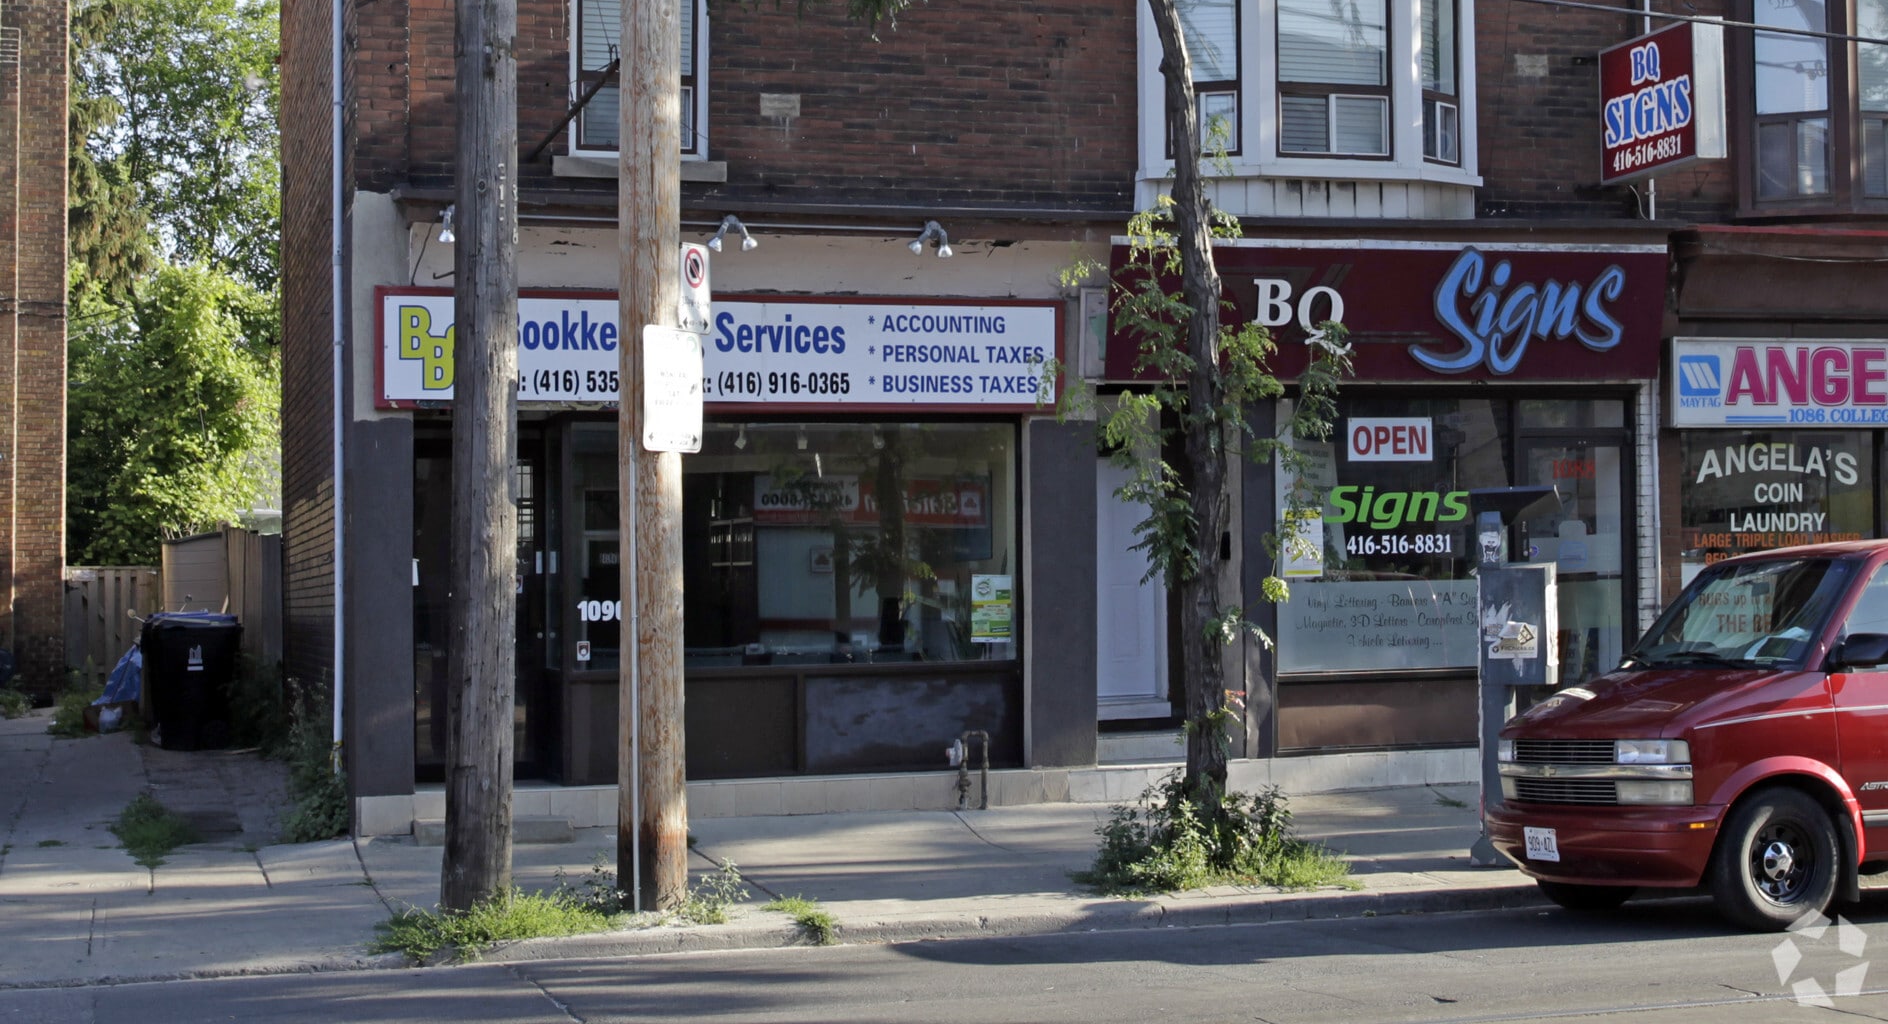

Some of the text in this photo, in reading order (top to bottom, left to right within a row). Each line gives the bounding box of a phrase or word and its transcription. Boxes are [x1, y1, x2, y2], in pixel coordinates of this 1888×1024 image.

[1630, 41, 1661, 86] BQ
[1604, 74, 1691, 149] SIGNS
[1613, 133, 1682, 172] 416-516-8831
[1252, 246, 1625, 374] BQ Signs
[714, 311, 847, 355] Services
[881, 314, 1007, 334] ACCOUNTING
[882, 344, 1045, 364] PERSONAL TAXES
[533, 369, 580, 396] (416)
[718, 371, 763, 397] (416)
[768, 372, 851, 394] 916-0365
[882, 375, 1039, 394] BUSINESS TAXES
[1725, 346, 1888, 406] ANGE
[1680, 396, 1721, 408] MAYTAG
[1353, 425, 1428, 456] OPEN
[1695, 442, 1859, 485] ANGELA'S
[1754, 482, 1803, 503] COIN
[1323, 485, 1470, 530] Signs
[1730, 512, 1826, 532] LAUNDRY
[1346, 533, 1452, 555] 416-516-8831
[1694, 533, 1732, 548] LARGE
[1735, 533, 1775, 547] TRIPLE
[1778, 532, 1809, 547] LOAD
[1716, 614, 1747, 633] THE
